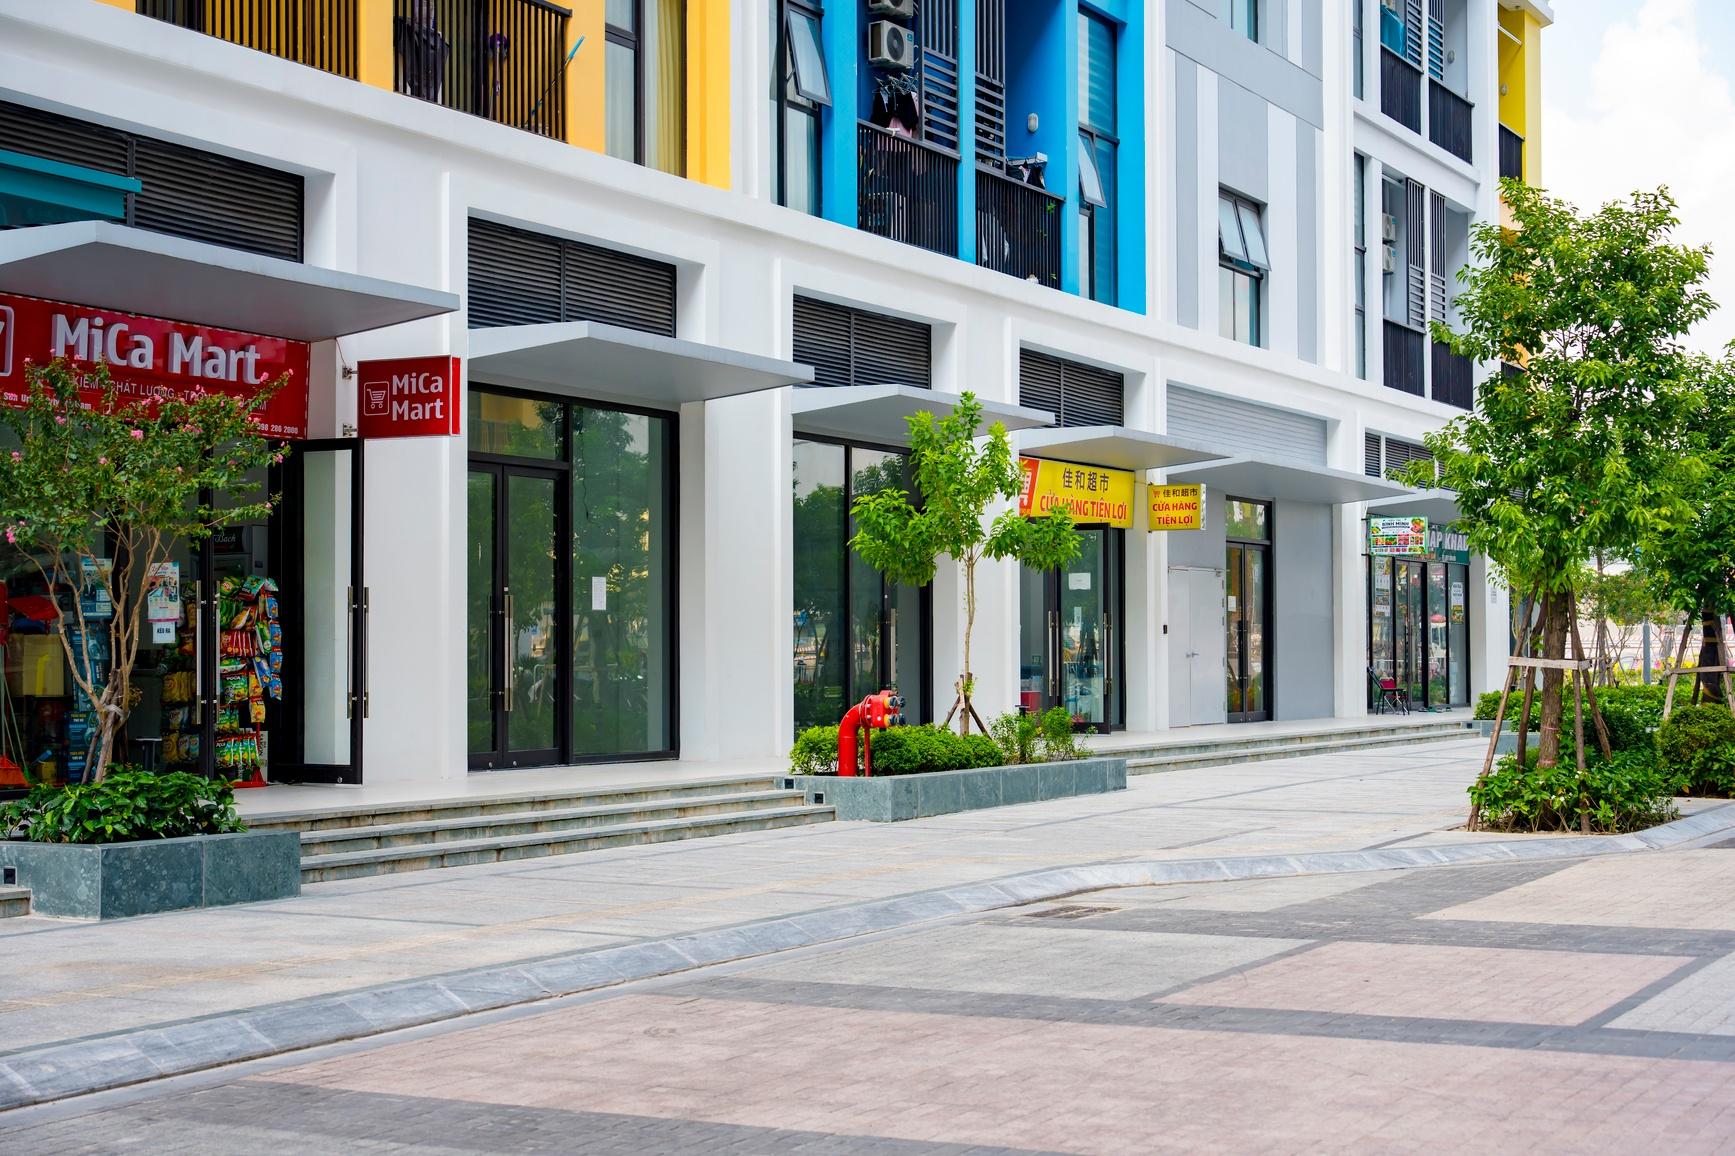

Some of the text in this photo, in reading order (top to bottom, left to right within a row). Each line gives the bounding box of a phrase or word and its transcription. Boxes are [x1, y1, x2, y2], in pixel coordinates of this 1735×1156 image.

[52, 313, 261, 385] MiCa Mart
[392, 372, 443, 395] MiCa
[392, 398, 444, 421] Mart
[1063, 467, 1110, 493] 佳和超市
[1163, 488, 1198, 498] 佳和超市
[1090, 497, 1111, 522] TIỆN
[1112, 501, 1127, 523] LỢI
[1152, 500, 1198, 511] CỬA HÀNG
[1156, 514, 1193, 527] TIỆN LỢI
